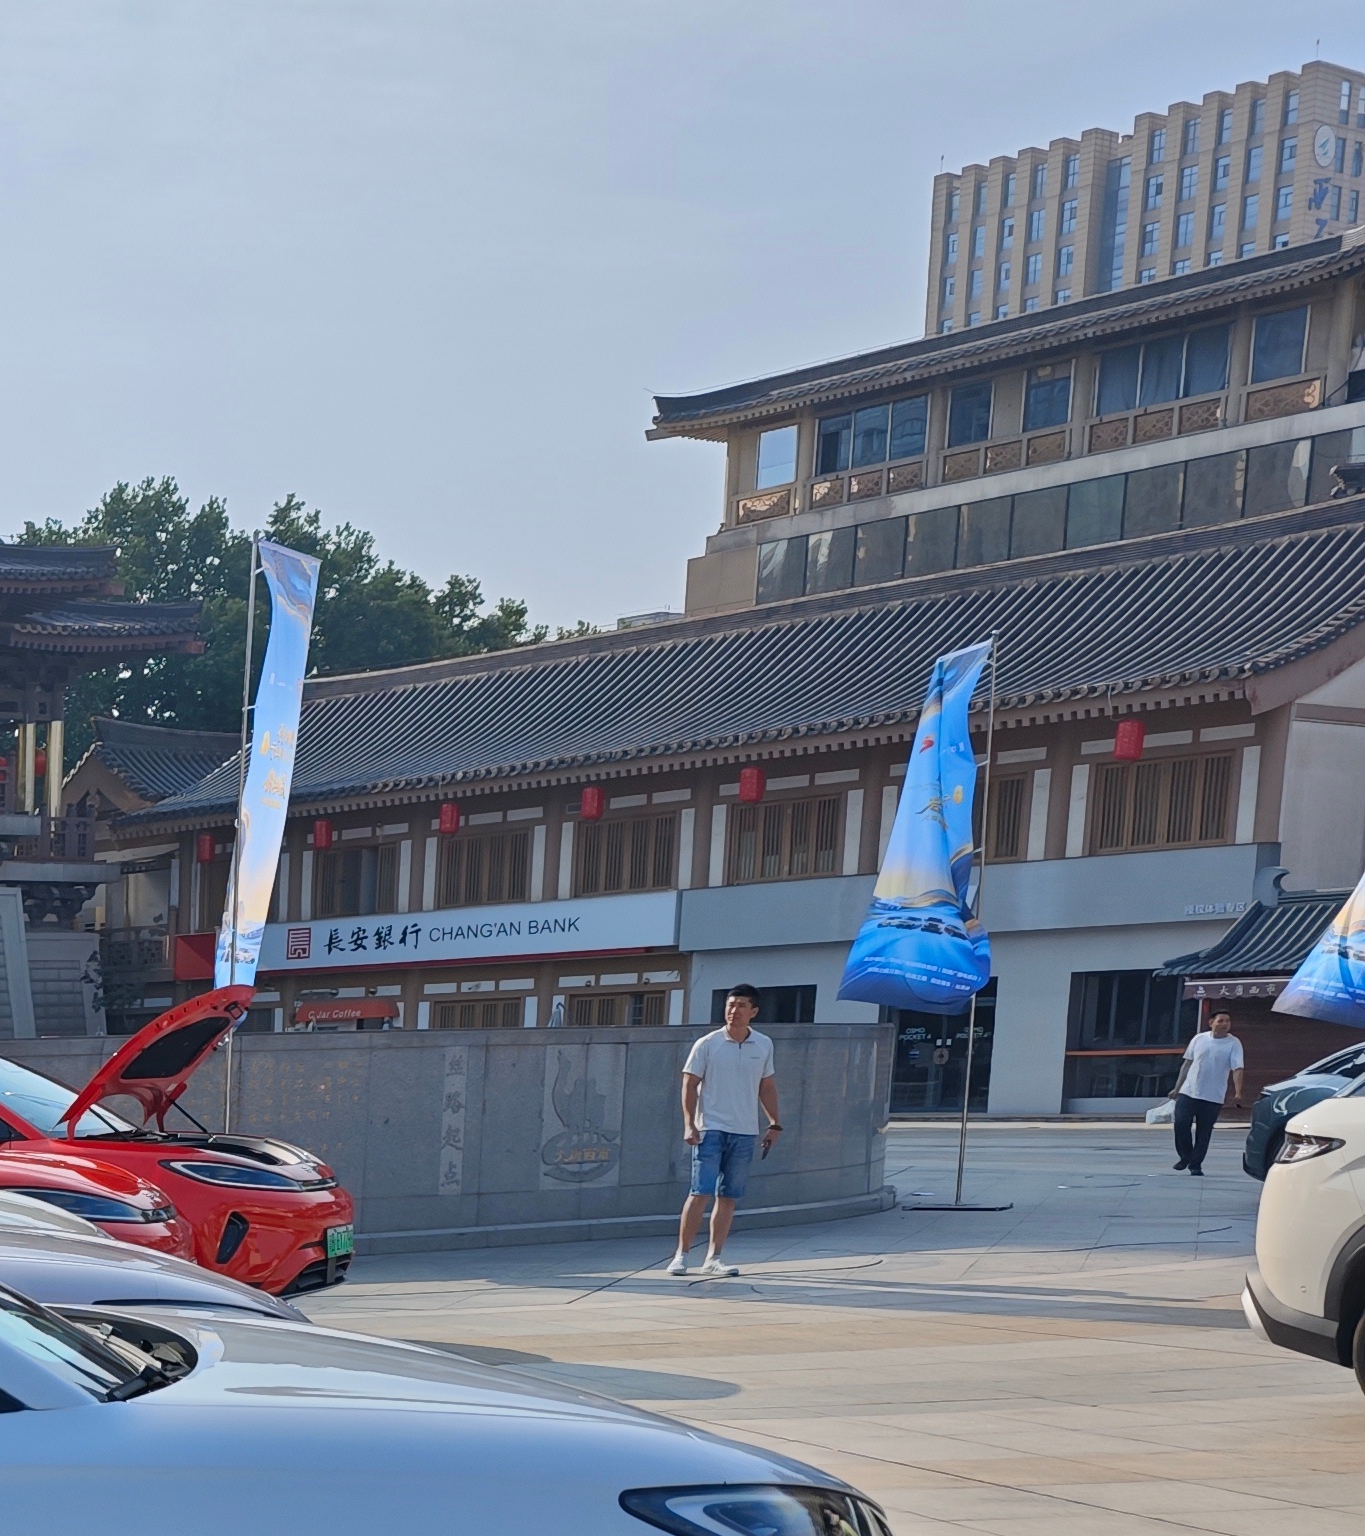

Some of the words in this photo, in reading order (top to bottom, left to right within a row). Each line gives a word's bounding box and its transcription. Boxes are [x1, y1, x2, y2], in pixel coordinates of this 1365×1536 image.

[428, 920, 521, 943] CHANG'AN
[527, 916, 581, 935] BANK
[332, 1009, 362, 1018] Coffee
[440, 1054, 466, 1188] 丝路起点
